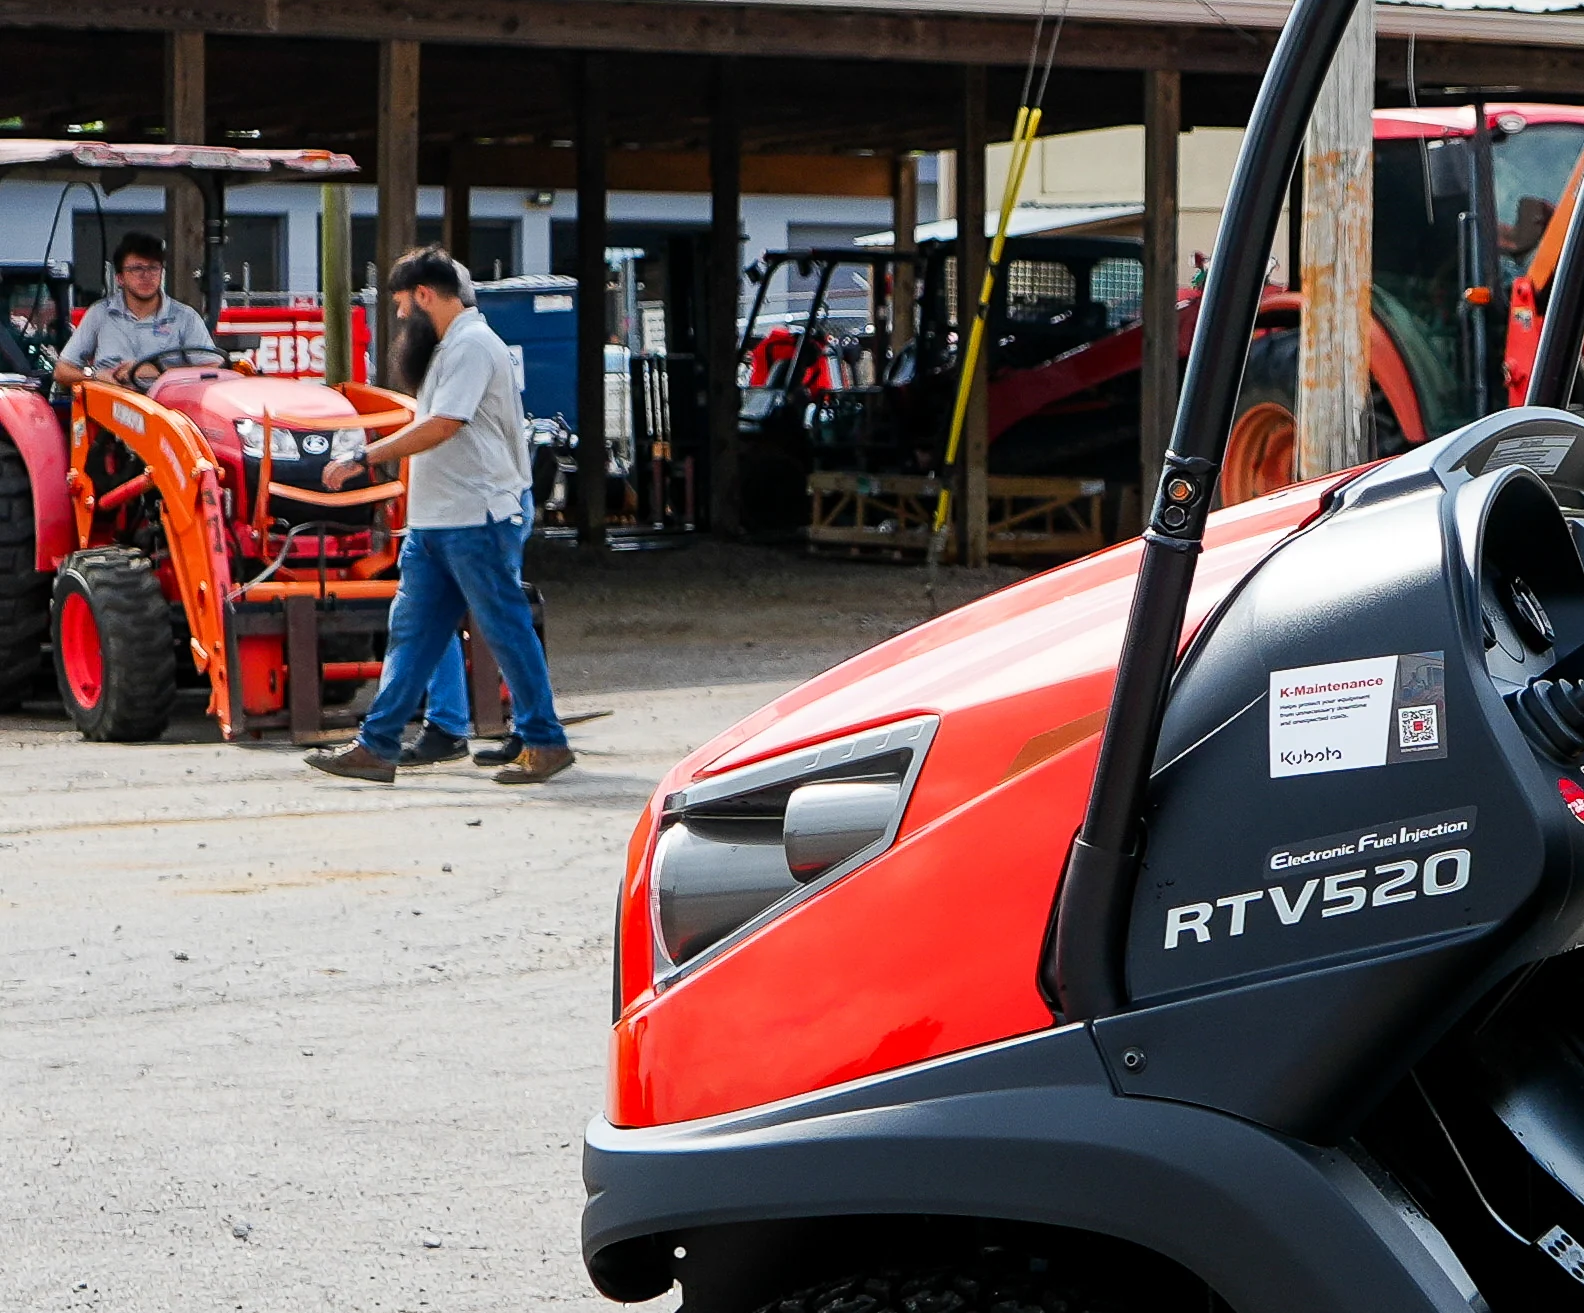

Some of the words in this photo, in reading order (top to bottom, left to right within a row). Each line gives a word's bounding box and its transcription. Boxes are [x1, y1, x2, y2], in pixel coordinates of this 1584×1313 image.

[1280, 678, 1384, 698] K-Maintenance
[1280, 746, 1342, 765] Kubota
[1270, 843, 1355, 870] Electronic
[1358, 834, 1398, 852] Fuel
[1400, 820, 1468, 843] Injection
[1164, 848, 1471, 950] RTV520
